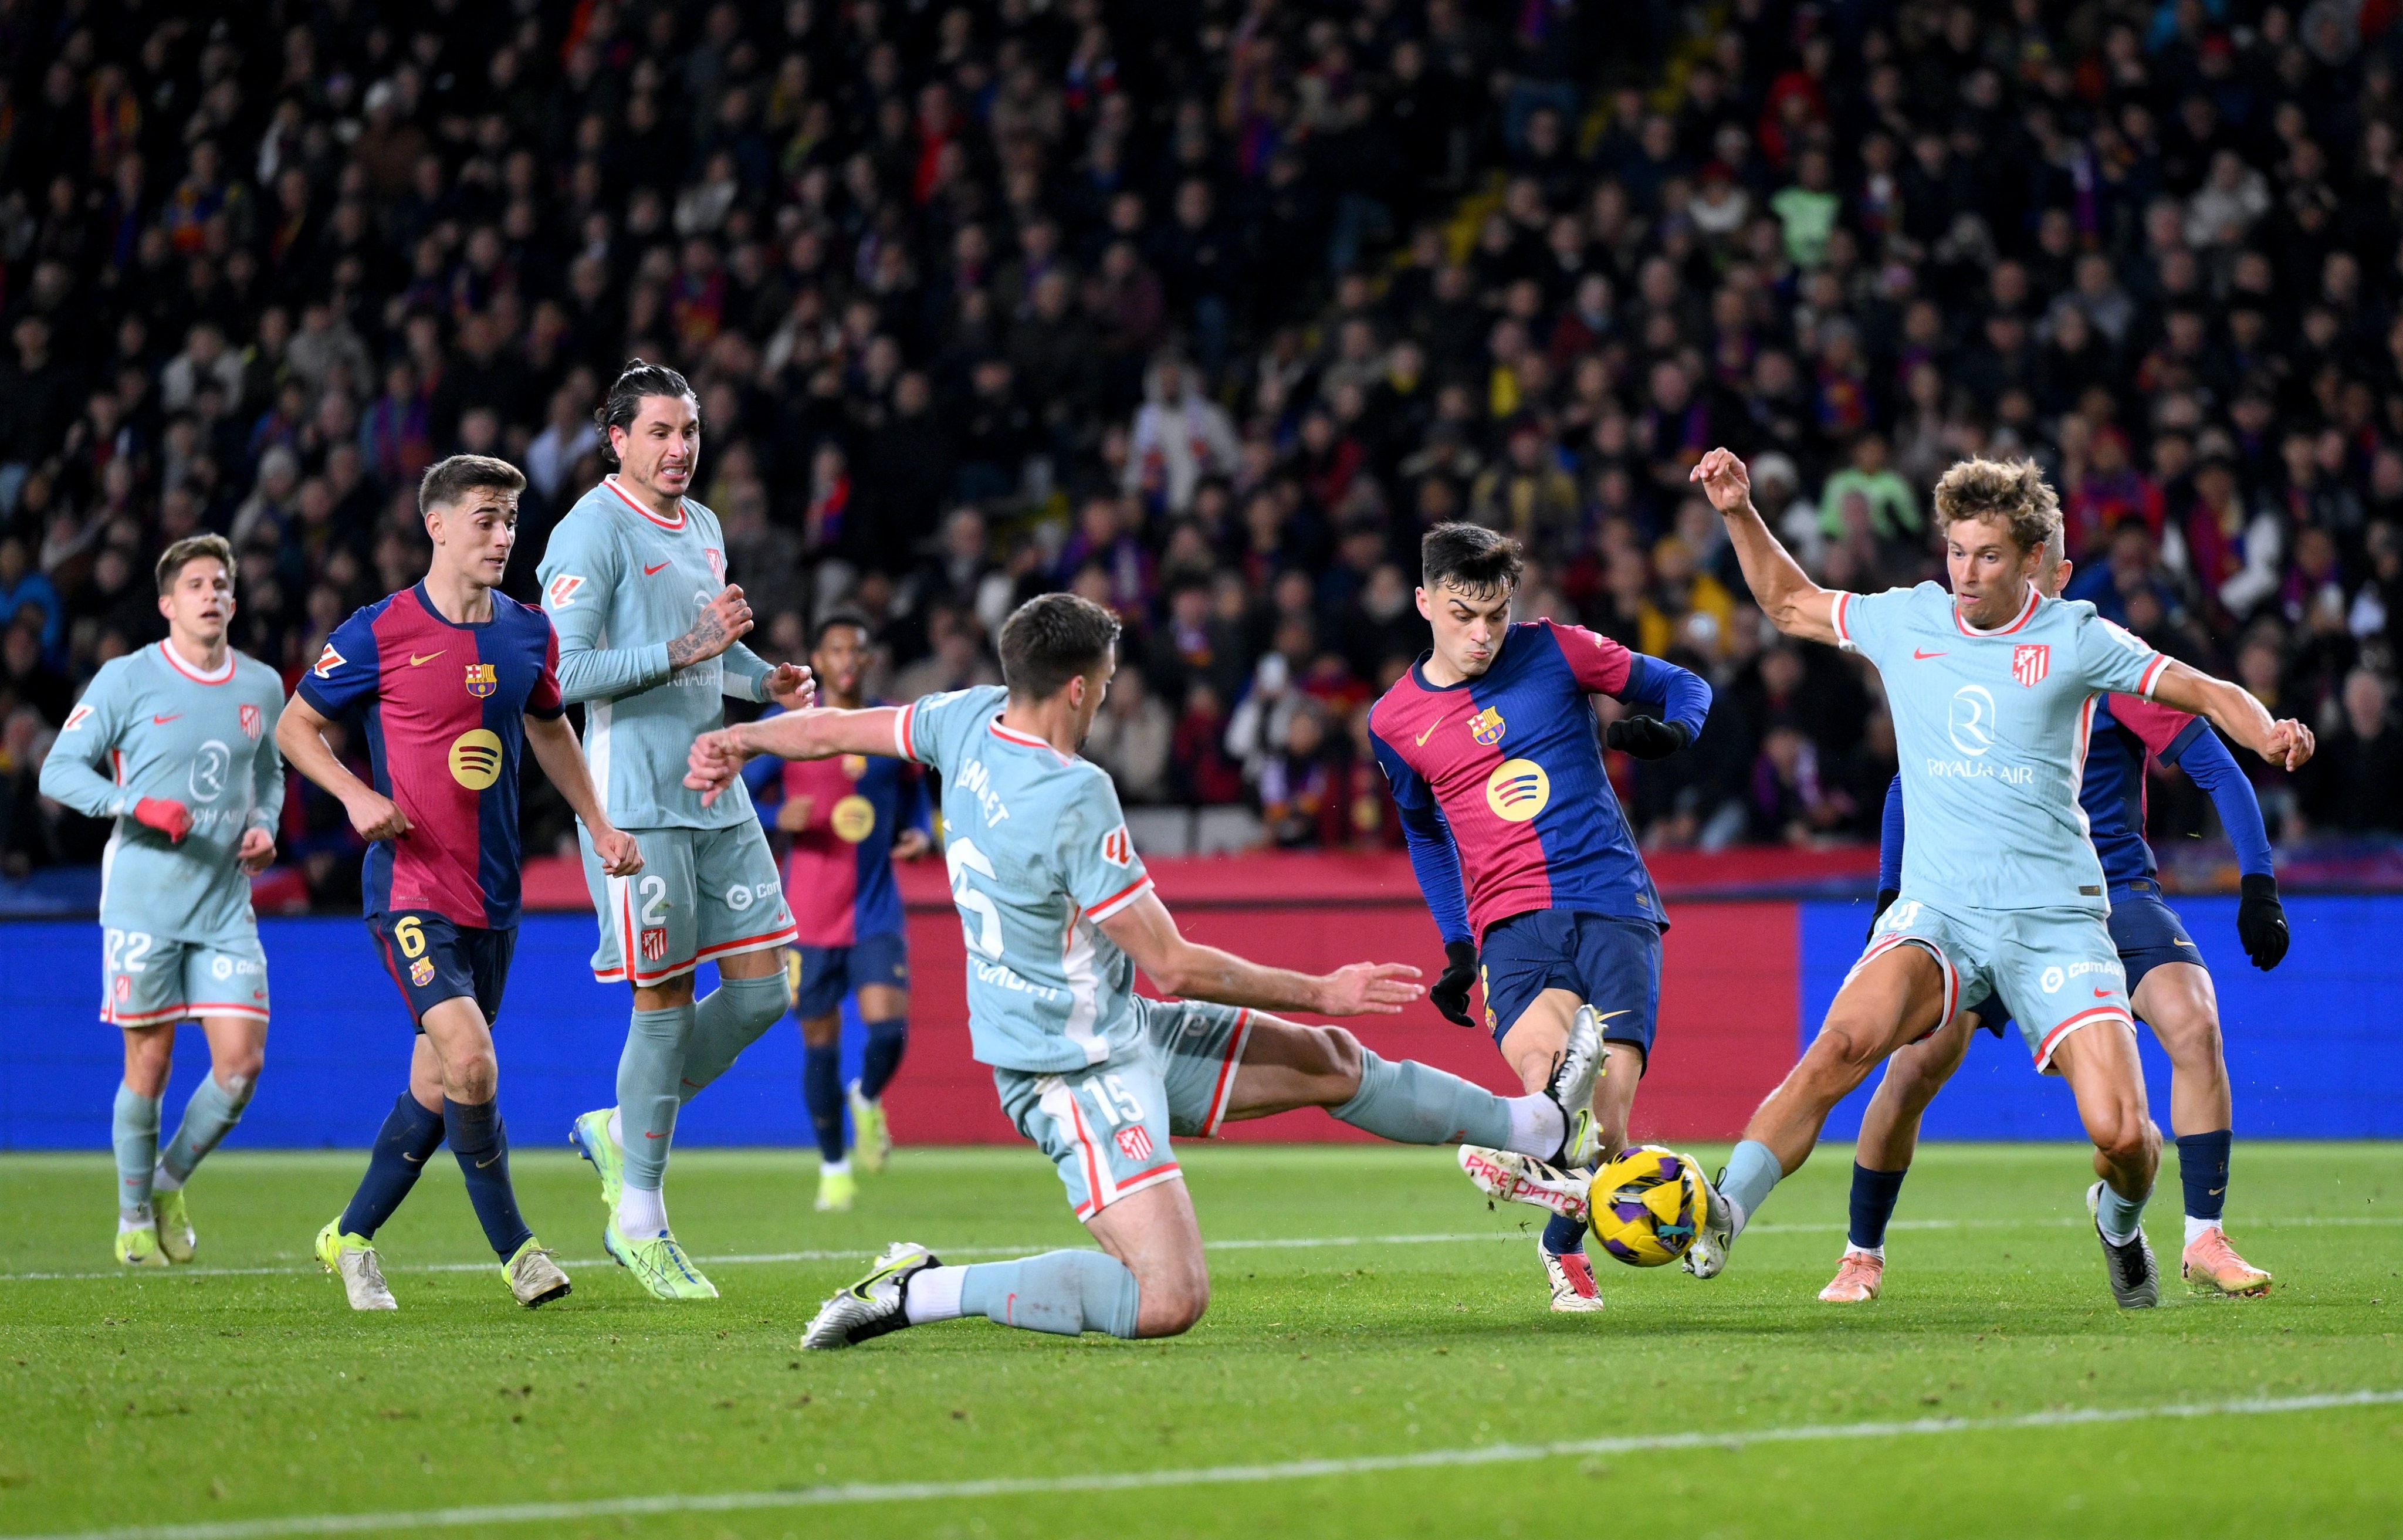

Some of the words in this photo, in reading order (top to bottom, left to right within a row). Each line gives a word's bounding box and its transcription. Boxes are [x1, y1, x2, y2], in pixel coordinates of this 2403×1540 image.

[955, 757, 1009, 828] ENET
[1927, 758, 1994, 777] RIYADH
[1999, 766, 2034, 784] AIR
[639, 875, 667, 926] 2
[942, 818, 1005, 963] 5
[110, 928, 151, 973] 22
[394, 916, 426, 959] 6
[967, 952, 1057, 1002] UNDAI
[1082, 1074, 1145, 1126] 15
